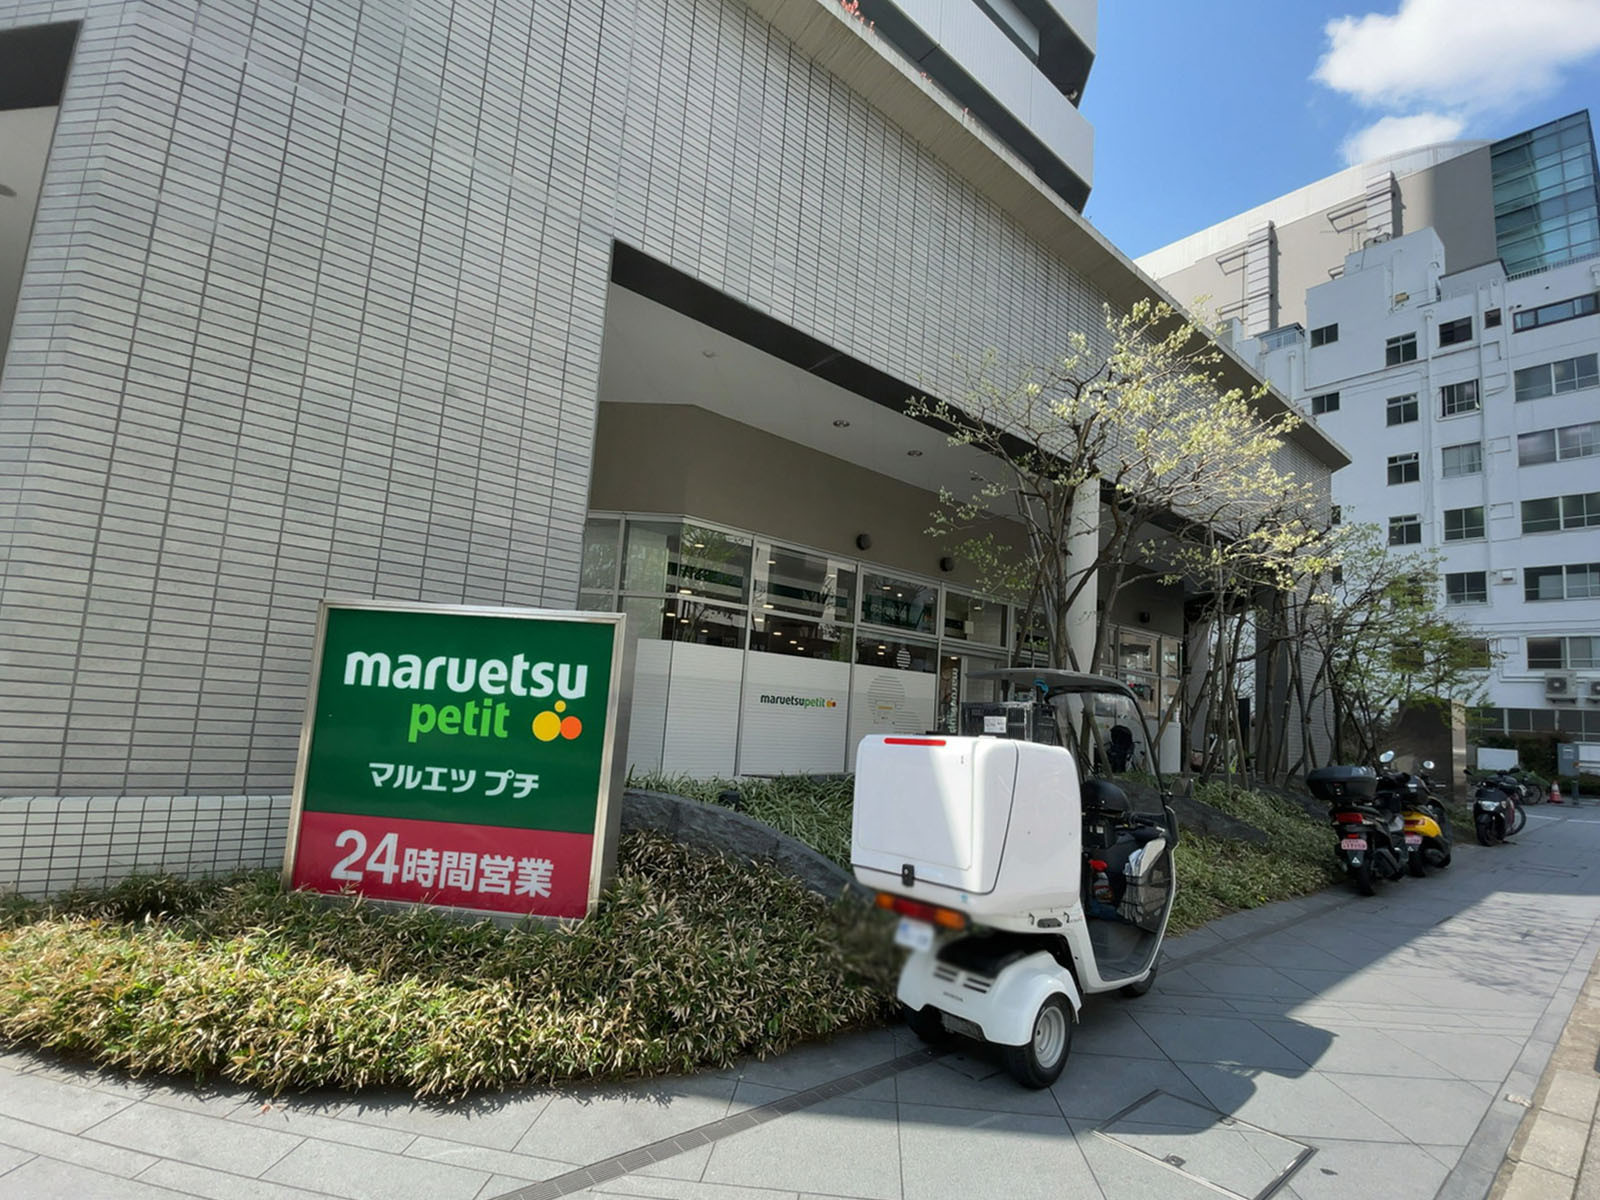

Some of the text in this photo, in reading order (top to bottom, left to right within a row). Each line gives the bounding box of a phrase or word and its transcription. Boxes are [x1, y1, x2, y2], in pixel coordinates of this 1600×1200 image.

[344, 651, 588, 699] maruetsu
[408, 698, 510, 743] petit
[331, 829, 554, 898] 24時間営業
